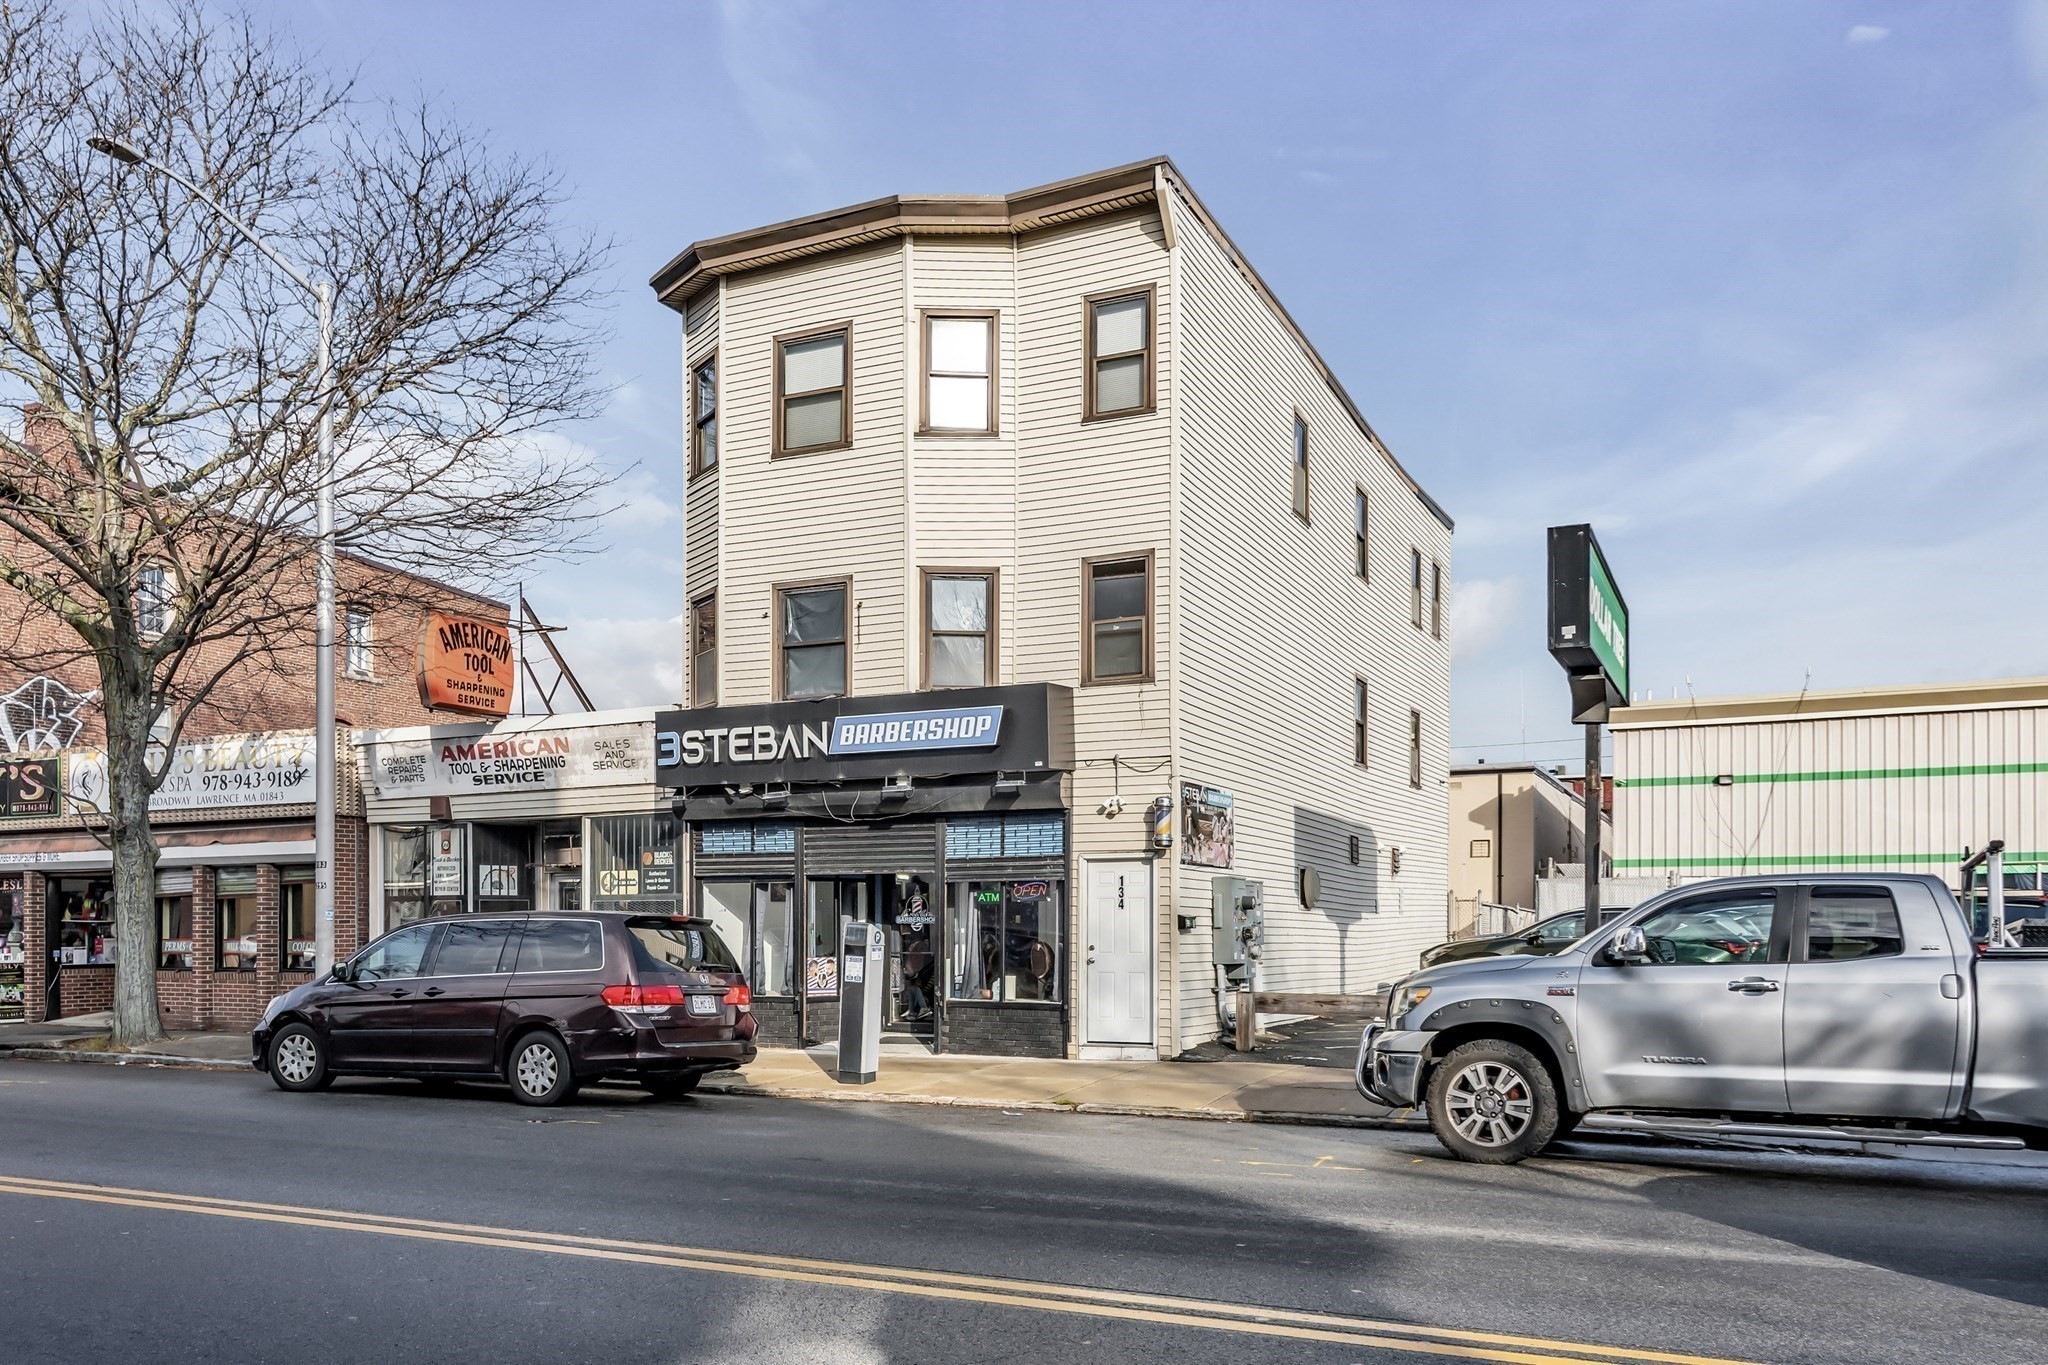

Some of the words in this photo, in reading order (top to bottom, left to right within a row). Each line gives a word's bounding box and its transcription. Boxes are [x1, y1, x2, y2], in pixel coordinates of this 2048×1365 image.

[439, 622, 511, 665] AMERICAN
[464, 653, 494, 675] TOOL
[446, 679, 505, 697] SHARPENING
[457, 694, 495, 708] SERVICE
[839, 715, 992, 747] BARBERSHOP
[441, 736, 570, 763] AMERICAN
[594, 739, 631, 751] SALES
[204, 742, 308, 773] BEAUTY
[381, 755, 427, 767] COMPLETE
[604, 750, 626, 760] AND
[387, 764, 424, 775] REPAIRS
[449, 763, 476, 776] TOOL
[480, 763, 490, 774] &
[494, 755, 566, 772] SHARPENING
[592, 758, 636, 771] SERVICE
[169, 776, 192, 792] SPA
[203, 771, 302, 792] 978-943-9189
[391, 775, 399, 783] &
[399, 773, 426, 783] PARTS
[472, 771, 545, 786] SERVICE
[978, 893, 1000, 902] ATM
[1013, 884, 1047, 897] OPEN
[1641, 1055, 1708, 1065] TUNDRA
